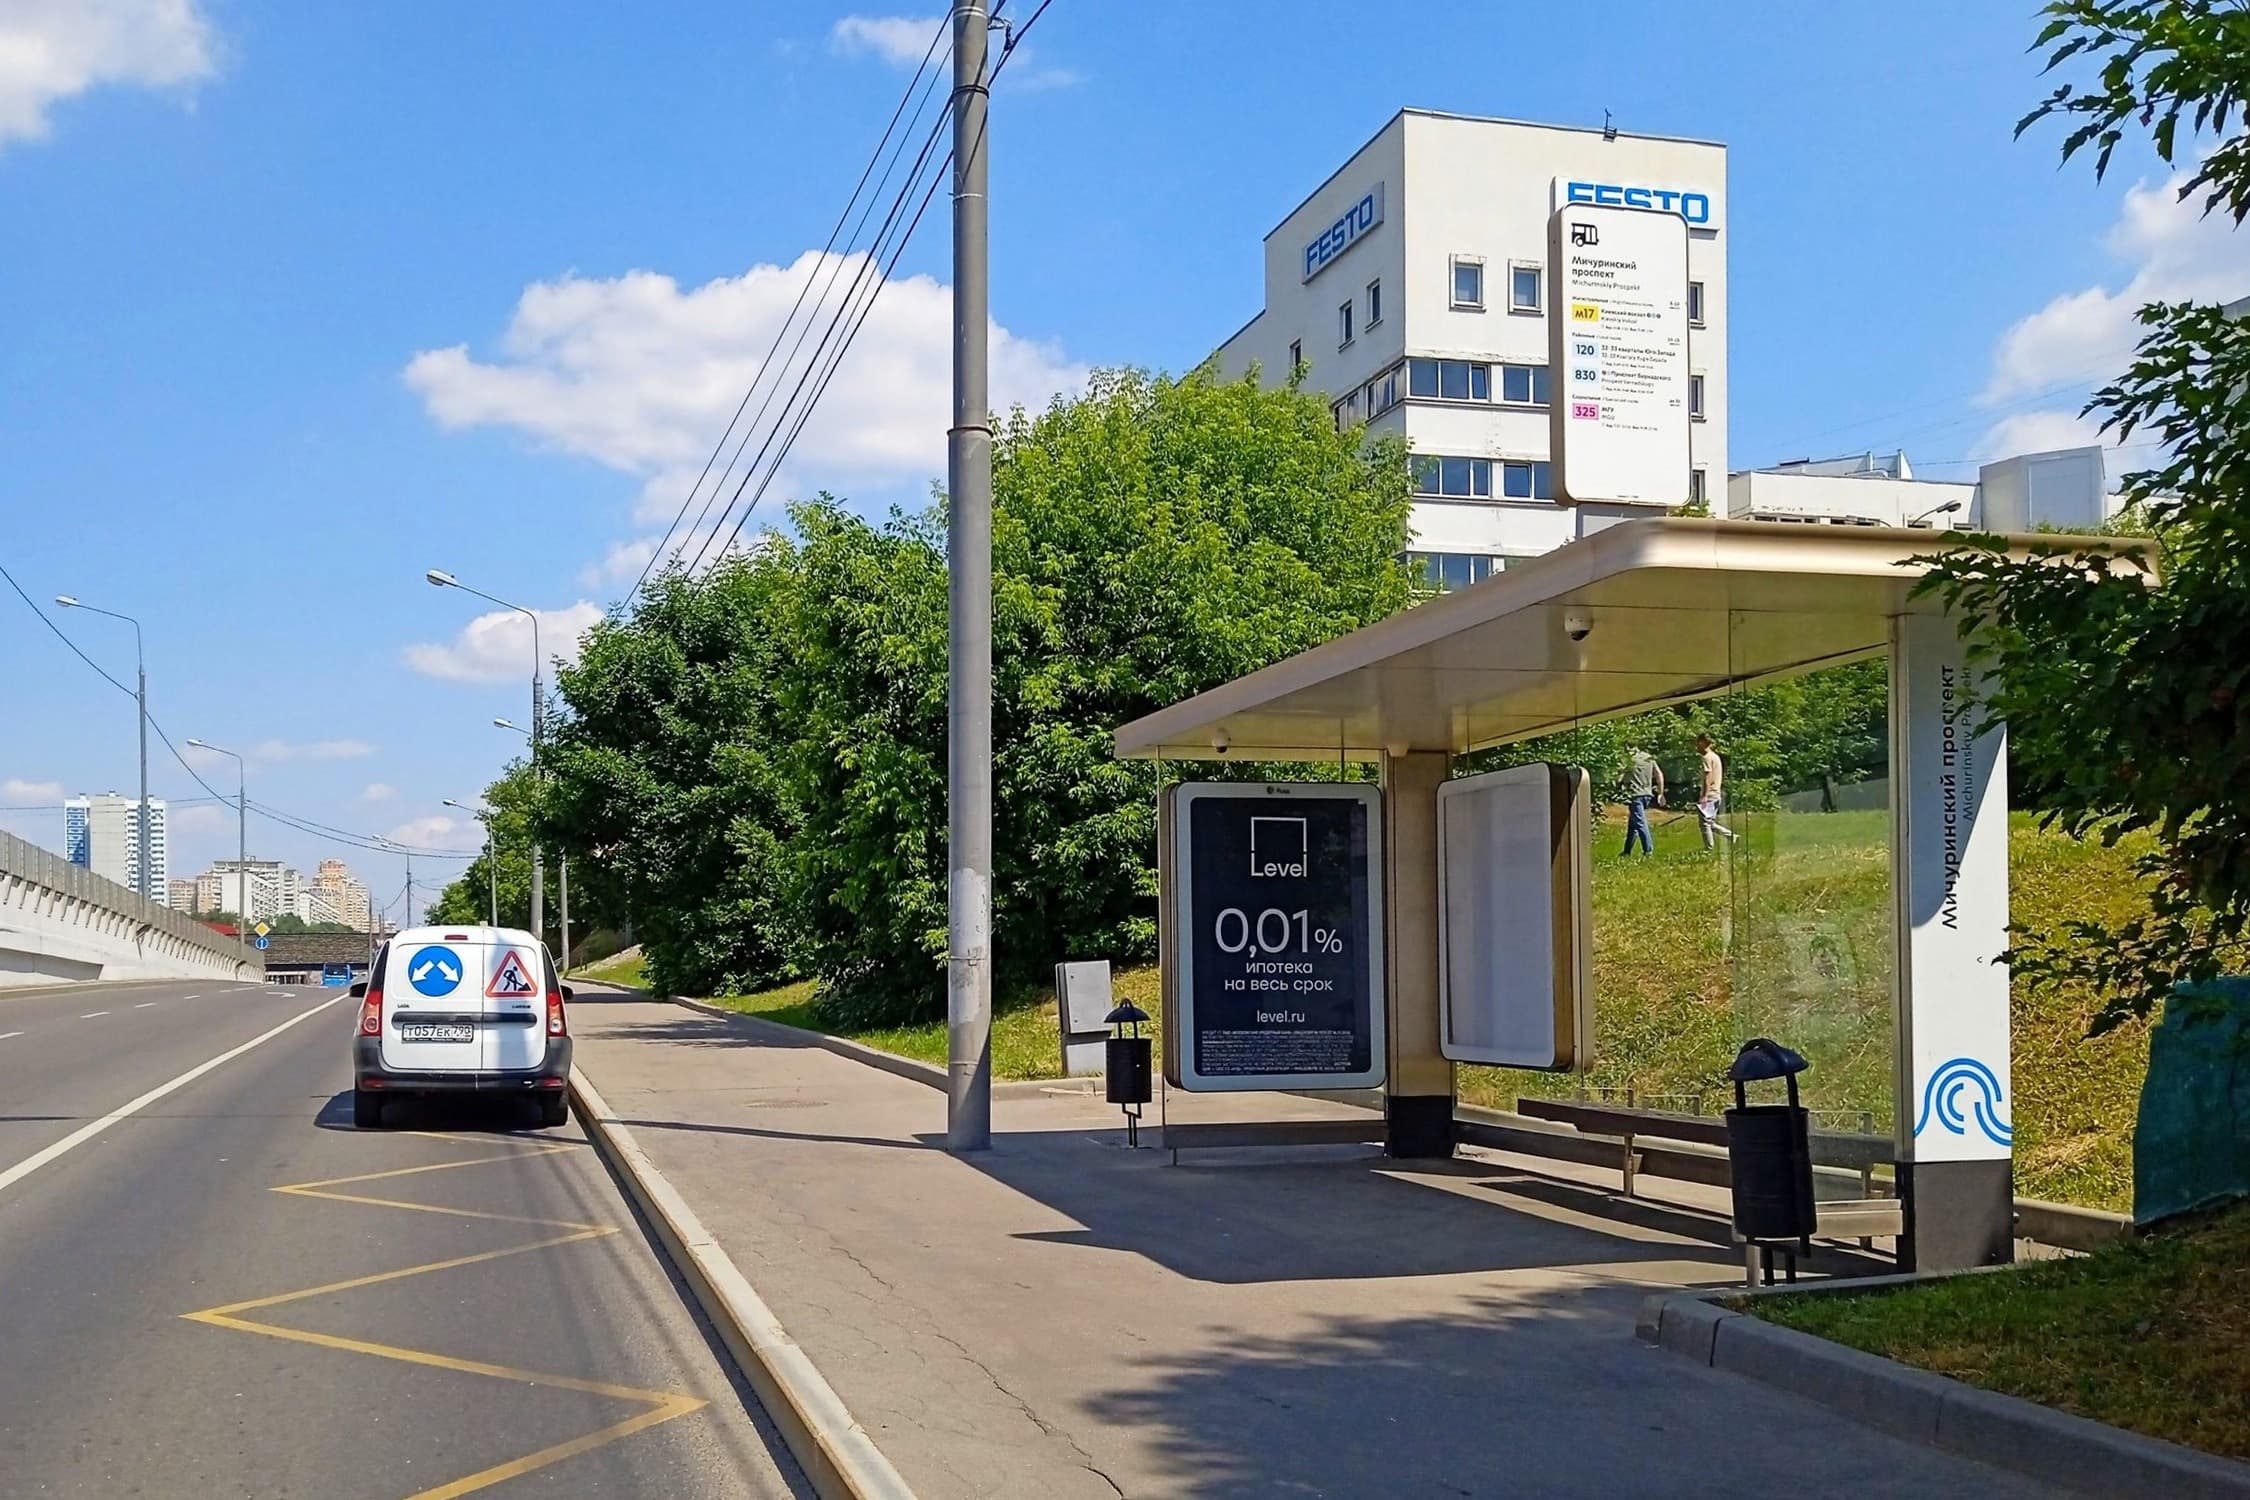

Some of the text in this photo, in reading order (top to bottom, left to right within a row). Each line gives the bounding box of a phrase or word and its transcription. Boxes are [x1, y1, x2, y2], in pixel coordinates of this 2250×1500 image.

[1567, 182, 1709, 224] FESTO
[1306, 194, 1373, 275] FESTO
[1572, 256, 1637, 270] Мичуринский
[1572, 268, 1615, 279] проспект
[1576, 344, 1595, 355] 120
[1575, 369, 1596, 381] 830
[1575, 406, 1596, 417] 325
[1960, 666, 1980, 821] Michurinskiy Proekt
[1940, 664, 1960, 930] Мичуринский проспект
[1251, 852, 1307, 878] Level
[1214, 908, 1343, 958] 0,01%
[1245, 960, 1313, 974] ипотека
[1224, 978, 1333, 994] на весь срок
[1256, 1009, 1305, 1023] level.ru
